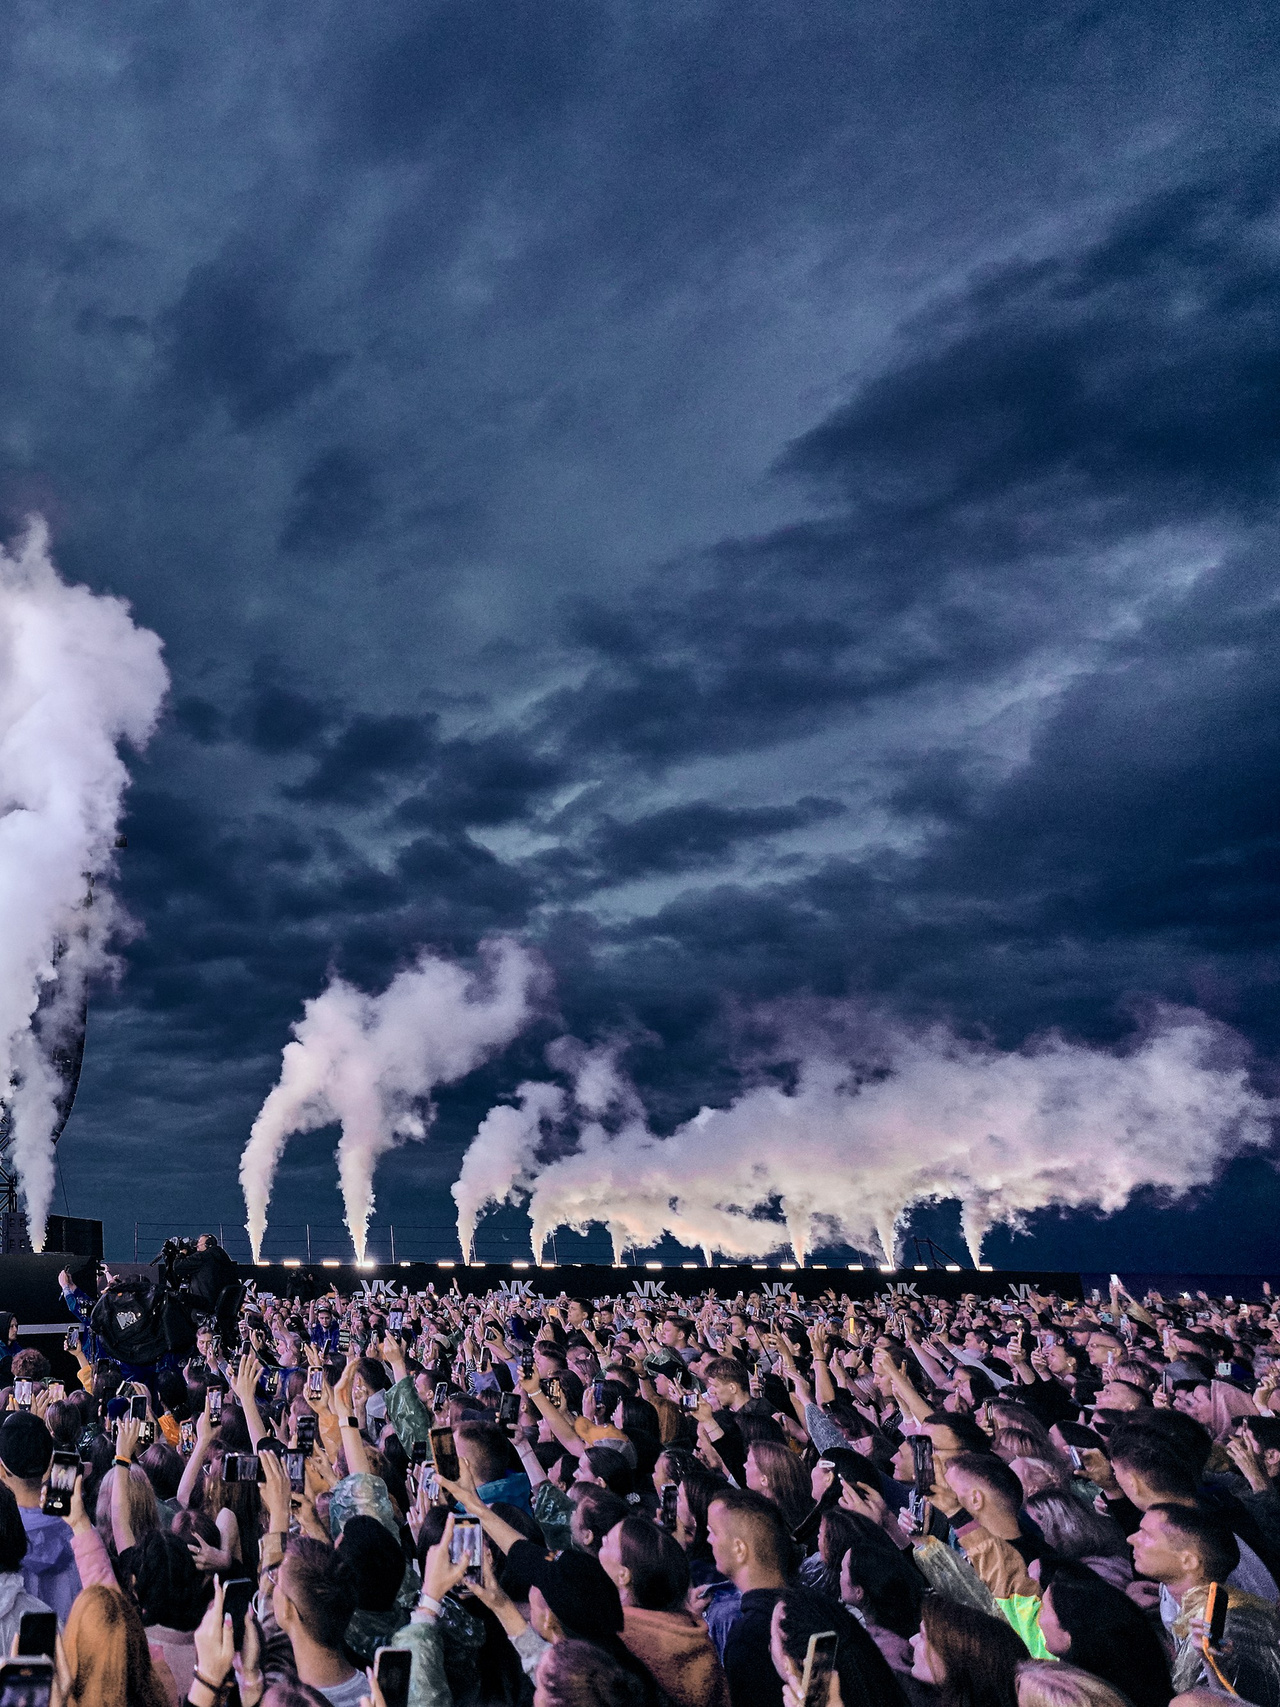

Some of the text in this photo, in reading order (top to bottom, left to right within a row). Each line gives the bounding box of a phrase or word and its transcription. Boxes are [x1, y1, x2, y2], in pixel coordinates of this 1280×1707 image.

[360, 1279, 398, 1297] VK
[499, 1280, 537, 1297] VK
[632, 1281, 669, 1298] VK
[761, 1282, 794, 1299] VK
